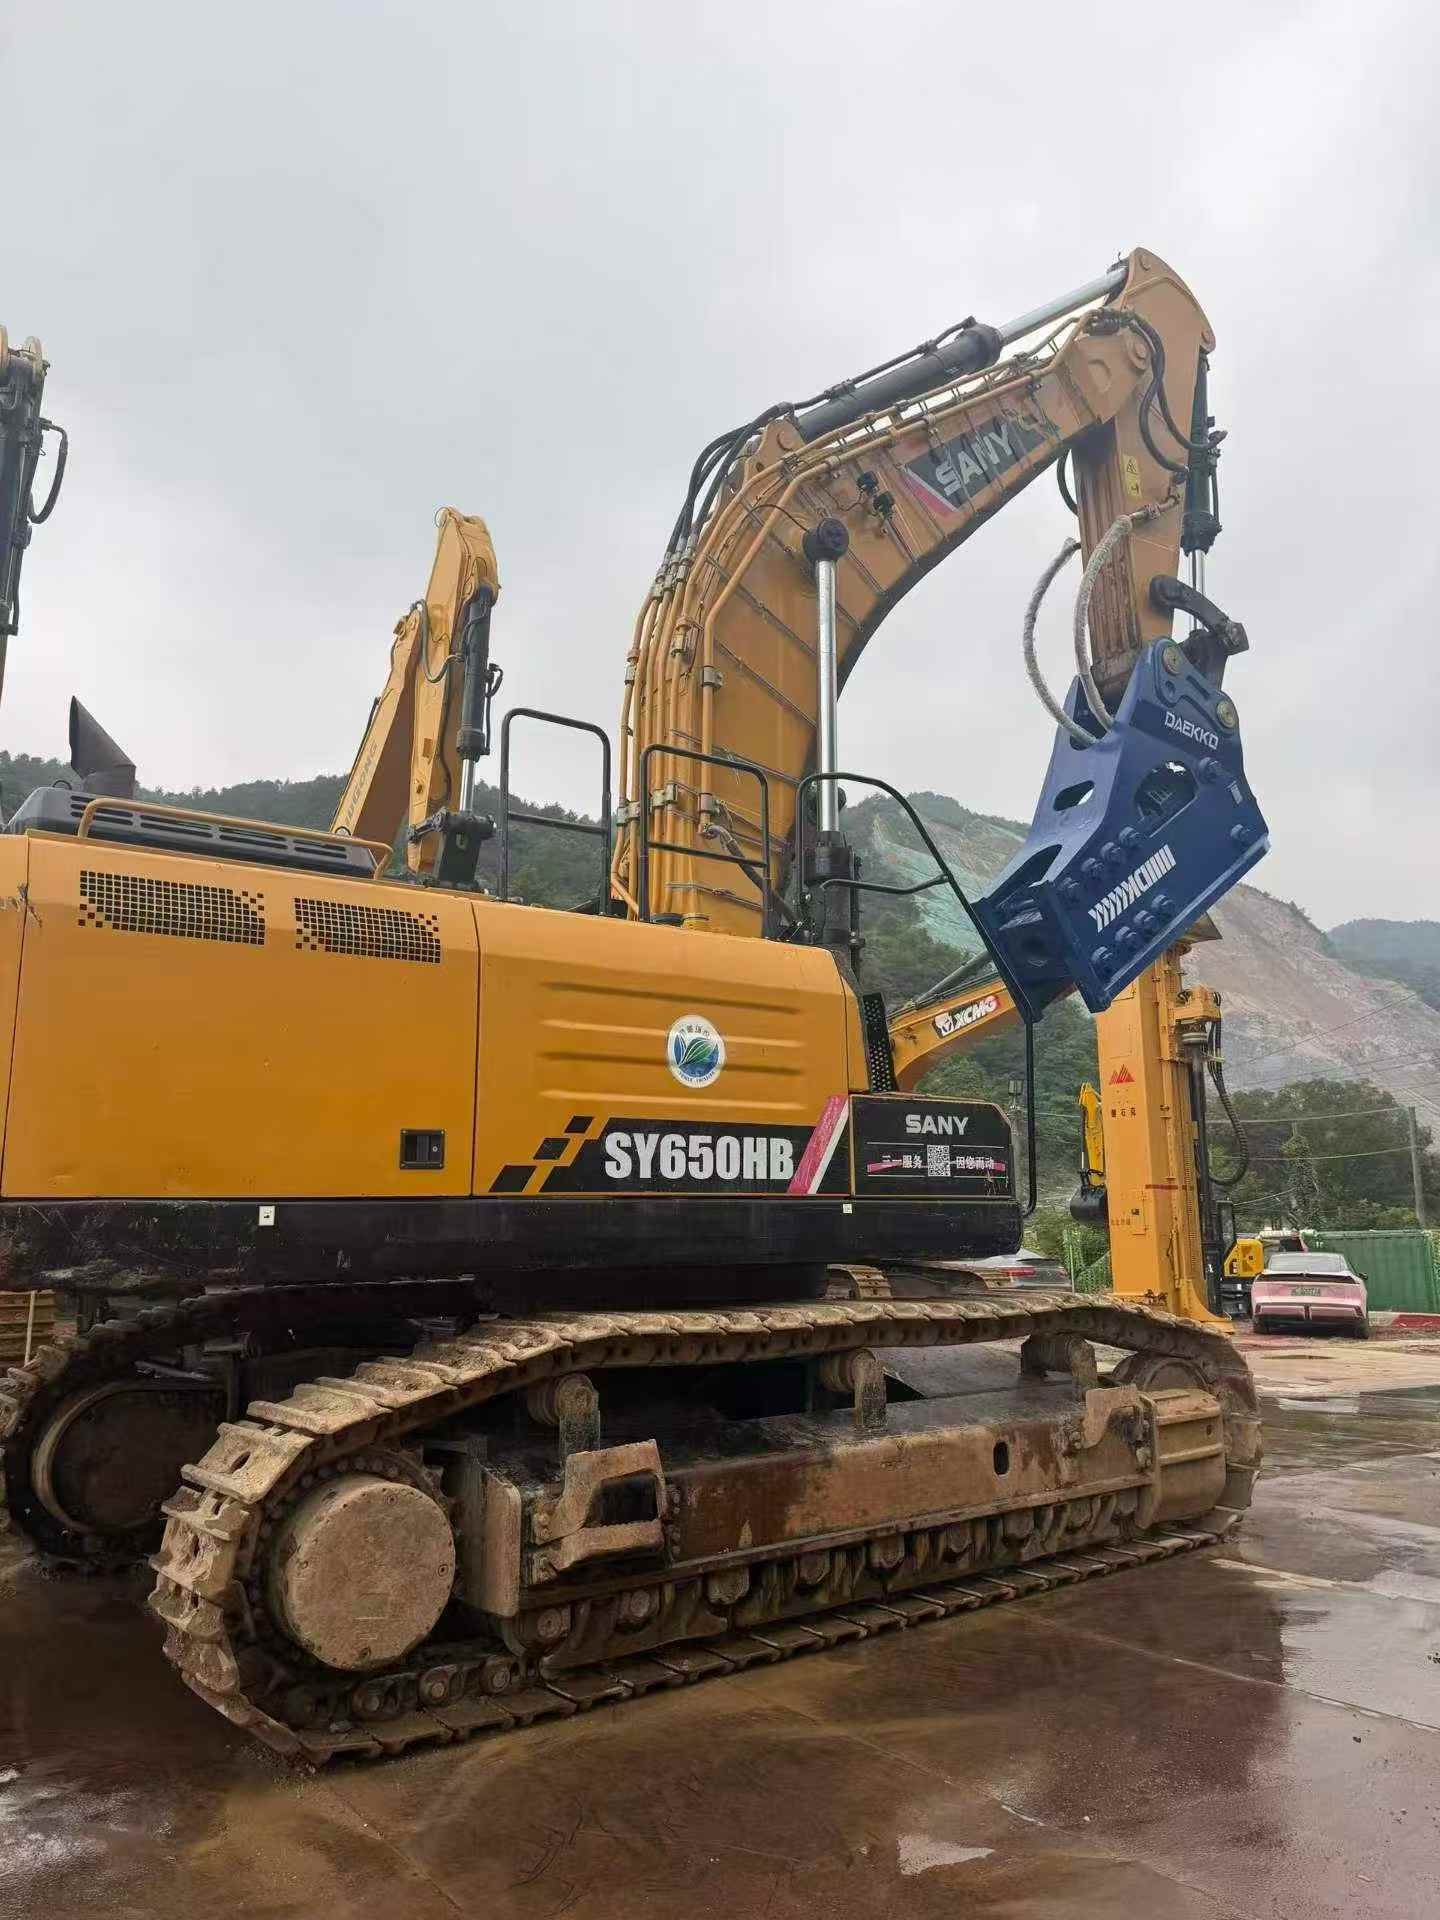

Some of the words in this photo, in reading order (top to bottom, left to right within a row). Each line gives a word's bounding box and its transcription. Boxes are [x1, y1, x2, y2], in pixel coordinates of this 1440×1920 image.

[935, 422, 1014, 497] SANY
[1164, 711, 1219, 750] DAEKKO
[905, 1114, 969, 1136] SANY
[604, 1132, 795, 1180] SY650HB
